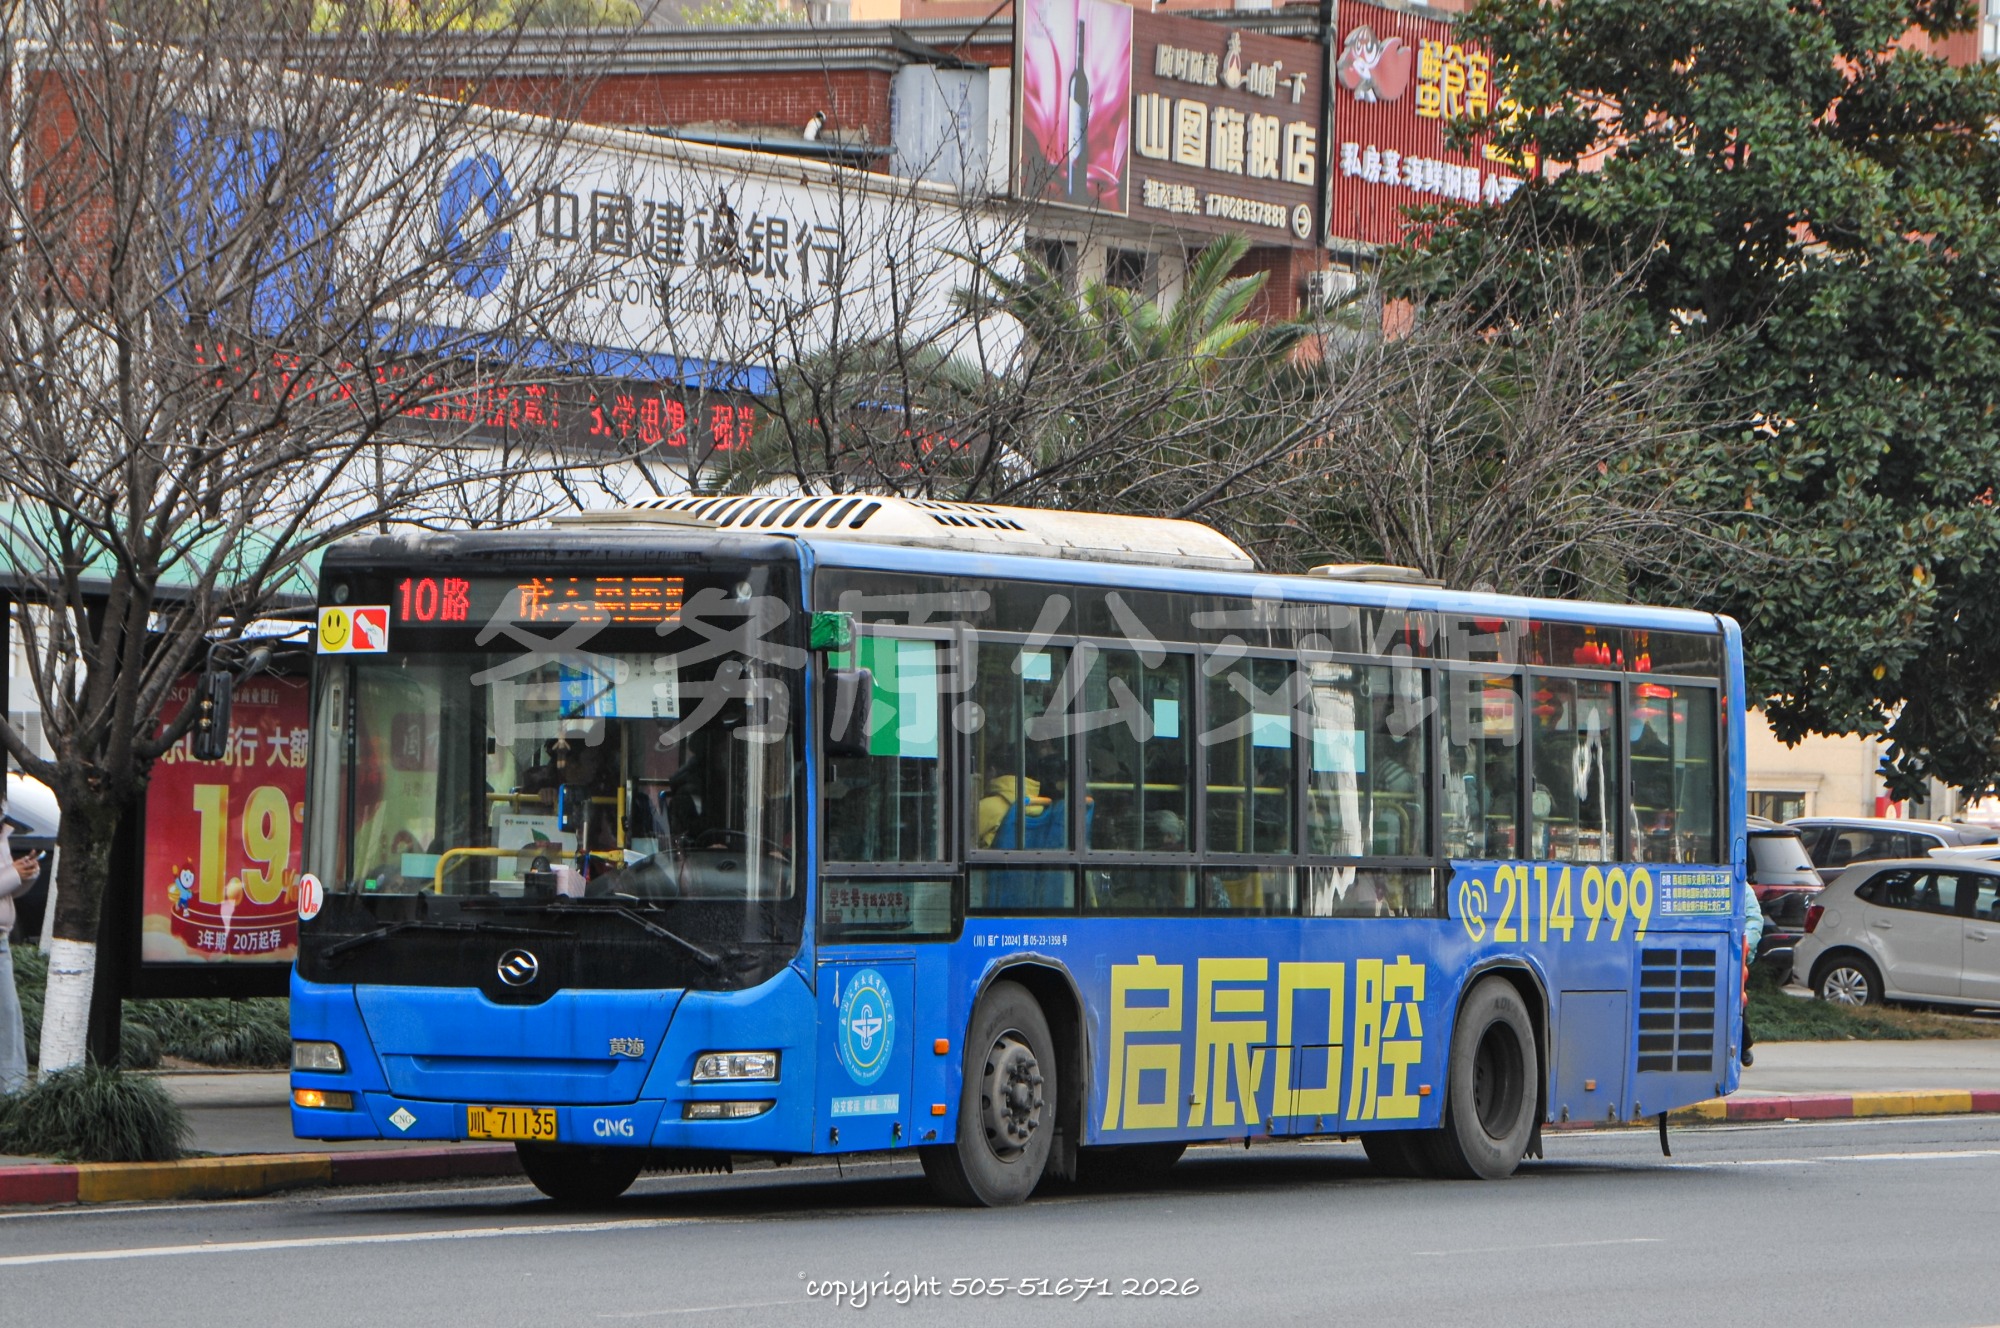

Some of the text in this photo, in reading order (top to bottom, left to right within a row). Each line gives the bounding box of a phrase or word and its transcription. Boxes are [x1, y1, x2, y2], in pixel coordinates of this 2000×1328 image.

[1136, 93, 1316, 186] 山图旗舰店
[535, 184, 841, 286] 中国建设银行
[399, 577, 470, 621] 10路
[233, 929, 281, 951] 20万起存
[609, 1037, 645, 1058] 黄海
[1101, 954, 1426, 1131] 启辰口腔
[392, 1113, 413, 1124] CNG
[593, 1118, 634, 1137] CNG
